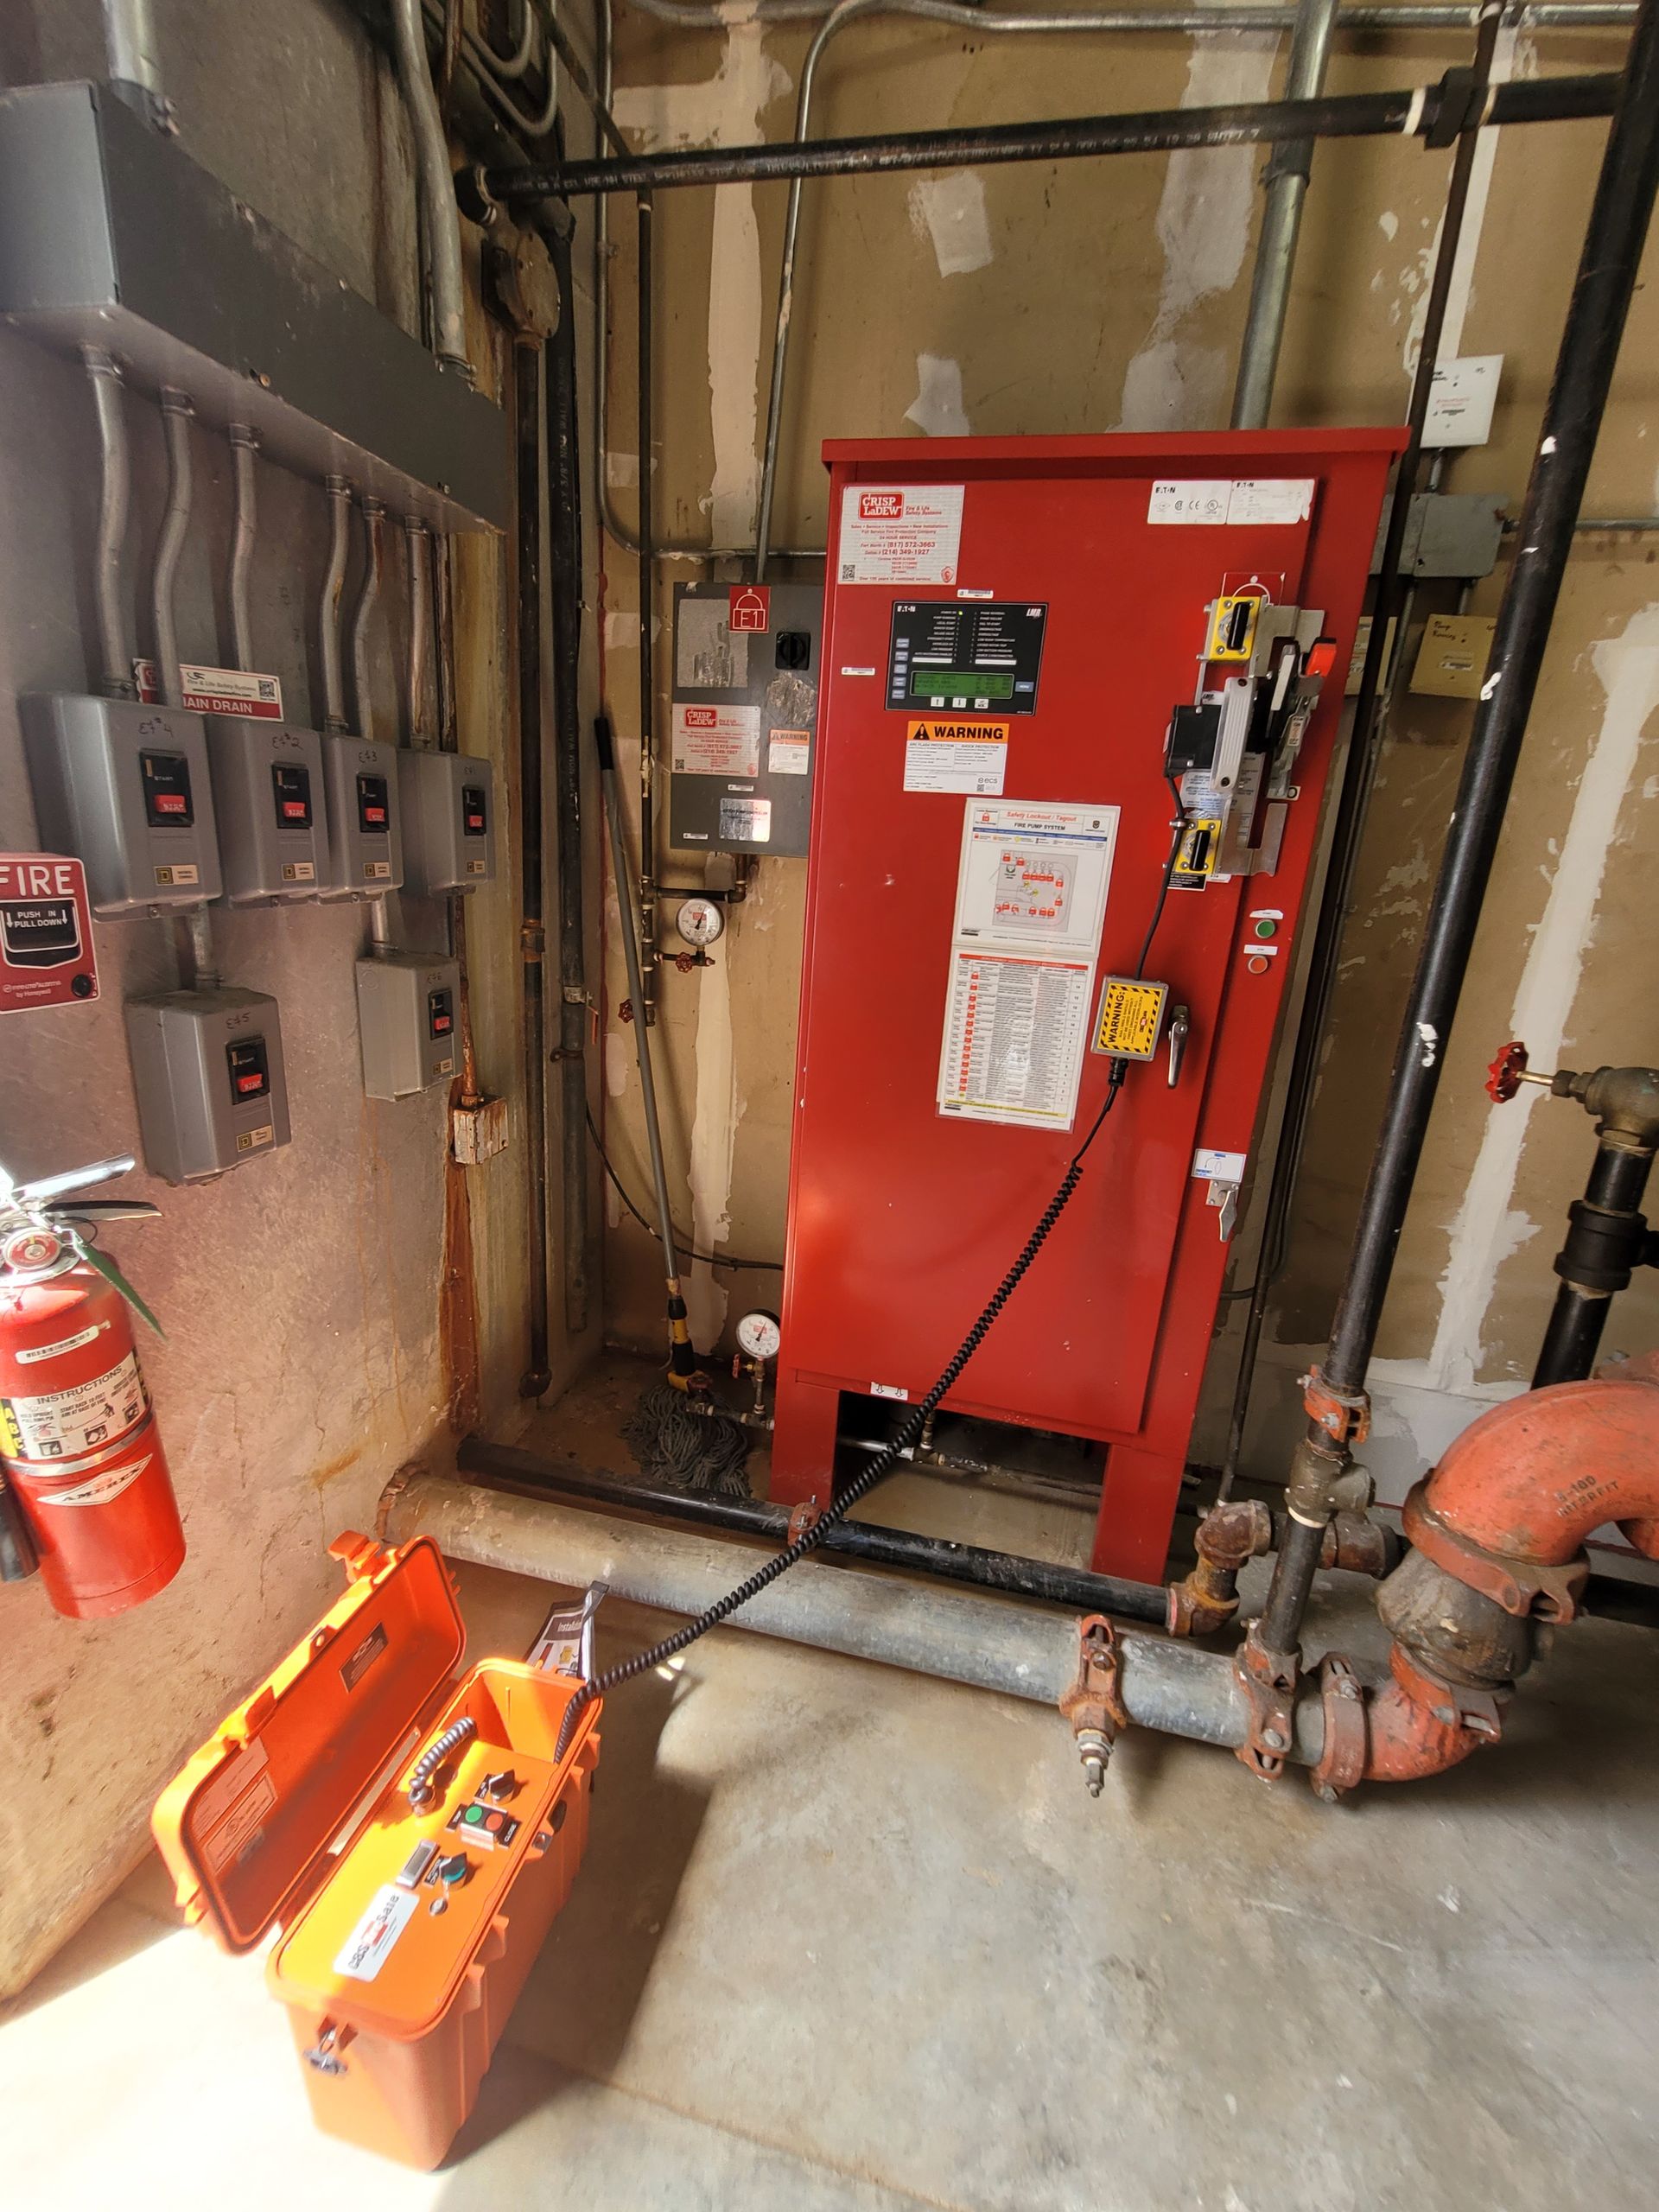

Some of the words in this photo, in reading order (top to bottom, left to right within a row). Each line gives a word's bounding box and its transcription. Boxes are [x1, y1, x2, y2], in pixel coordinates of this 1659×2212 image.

[862, 493, 896, 506] CRISP
[864, 506, 902, 516] LaDEW
[741, 610, 759, 628] E1
[213, 700, 253, 714] DRAIN
[687, 710, 712, 719] CRISP
[780, 733, 807, 741] WARNING
[934, 726, 1003, 740] WARNING
[1007, 810, 1025, 819] Safety
[38, 918, 62, 926] DOWN
[1108, 991, 1125, 1044] WARNING:
[37, 1365, 123, 1405] INSTRUCTIONS
[4, 1408, 15, 1420] A
[8, 1422, 19, 1434] B
[62, 1464, 143, 1502] AMEREX
[503, 1822, 518, 1843] CLOSE
